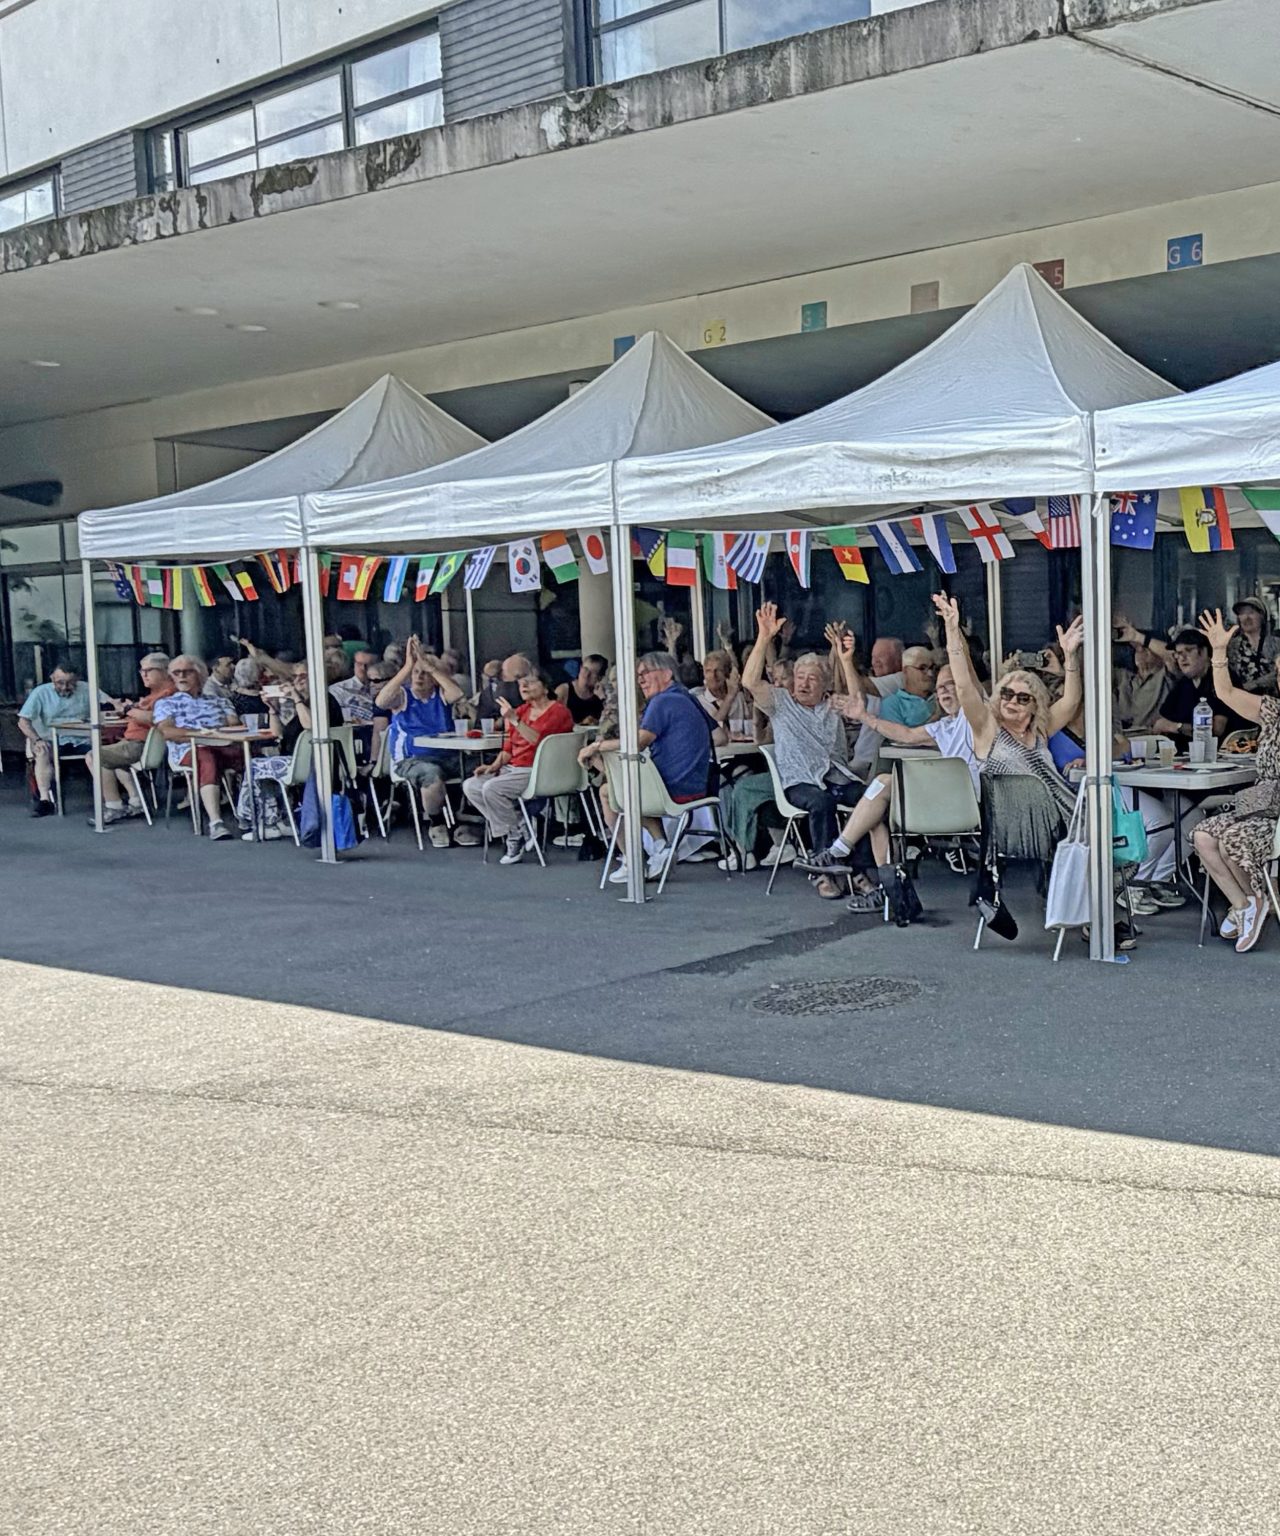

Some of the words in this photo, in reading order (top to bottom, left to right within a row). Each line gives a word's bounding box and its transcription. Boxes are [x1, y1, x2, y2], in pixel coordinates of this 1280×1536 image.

[1168, 245, 1181, 265] G
[1191, 241, 1202, 261] 6
[1054, 267, 1063, 285] 5
[703, 328, 712, 344] G
[719, 326, 726, 342] 2
